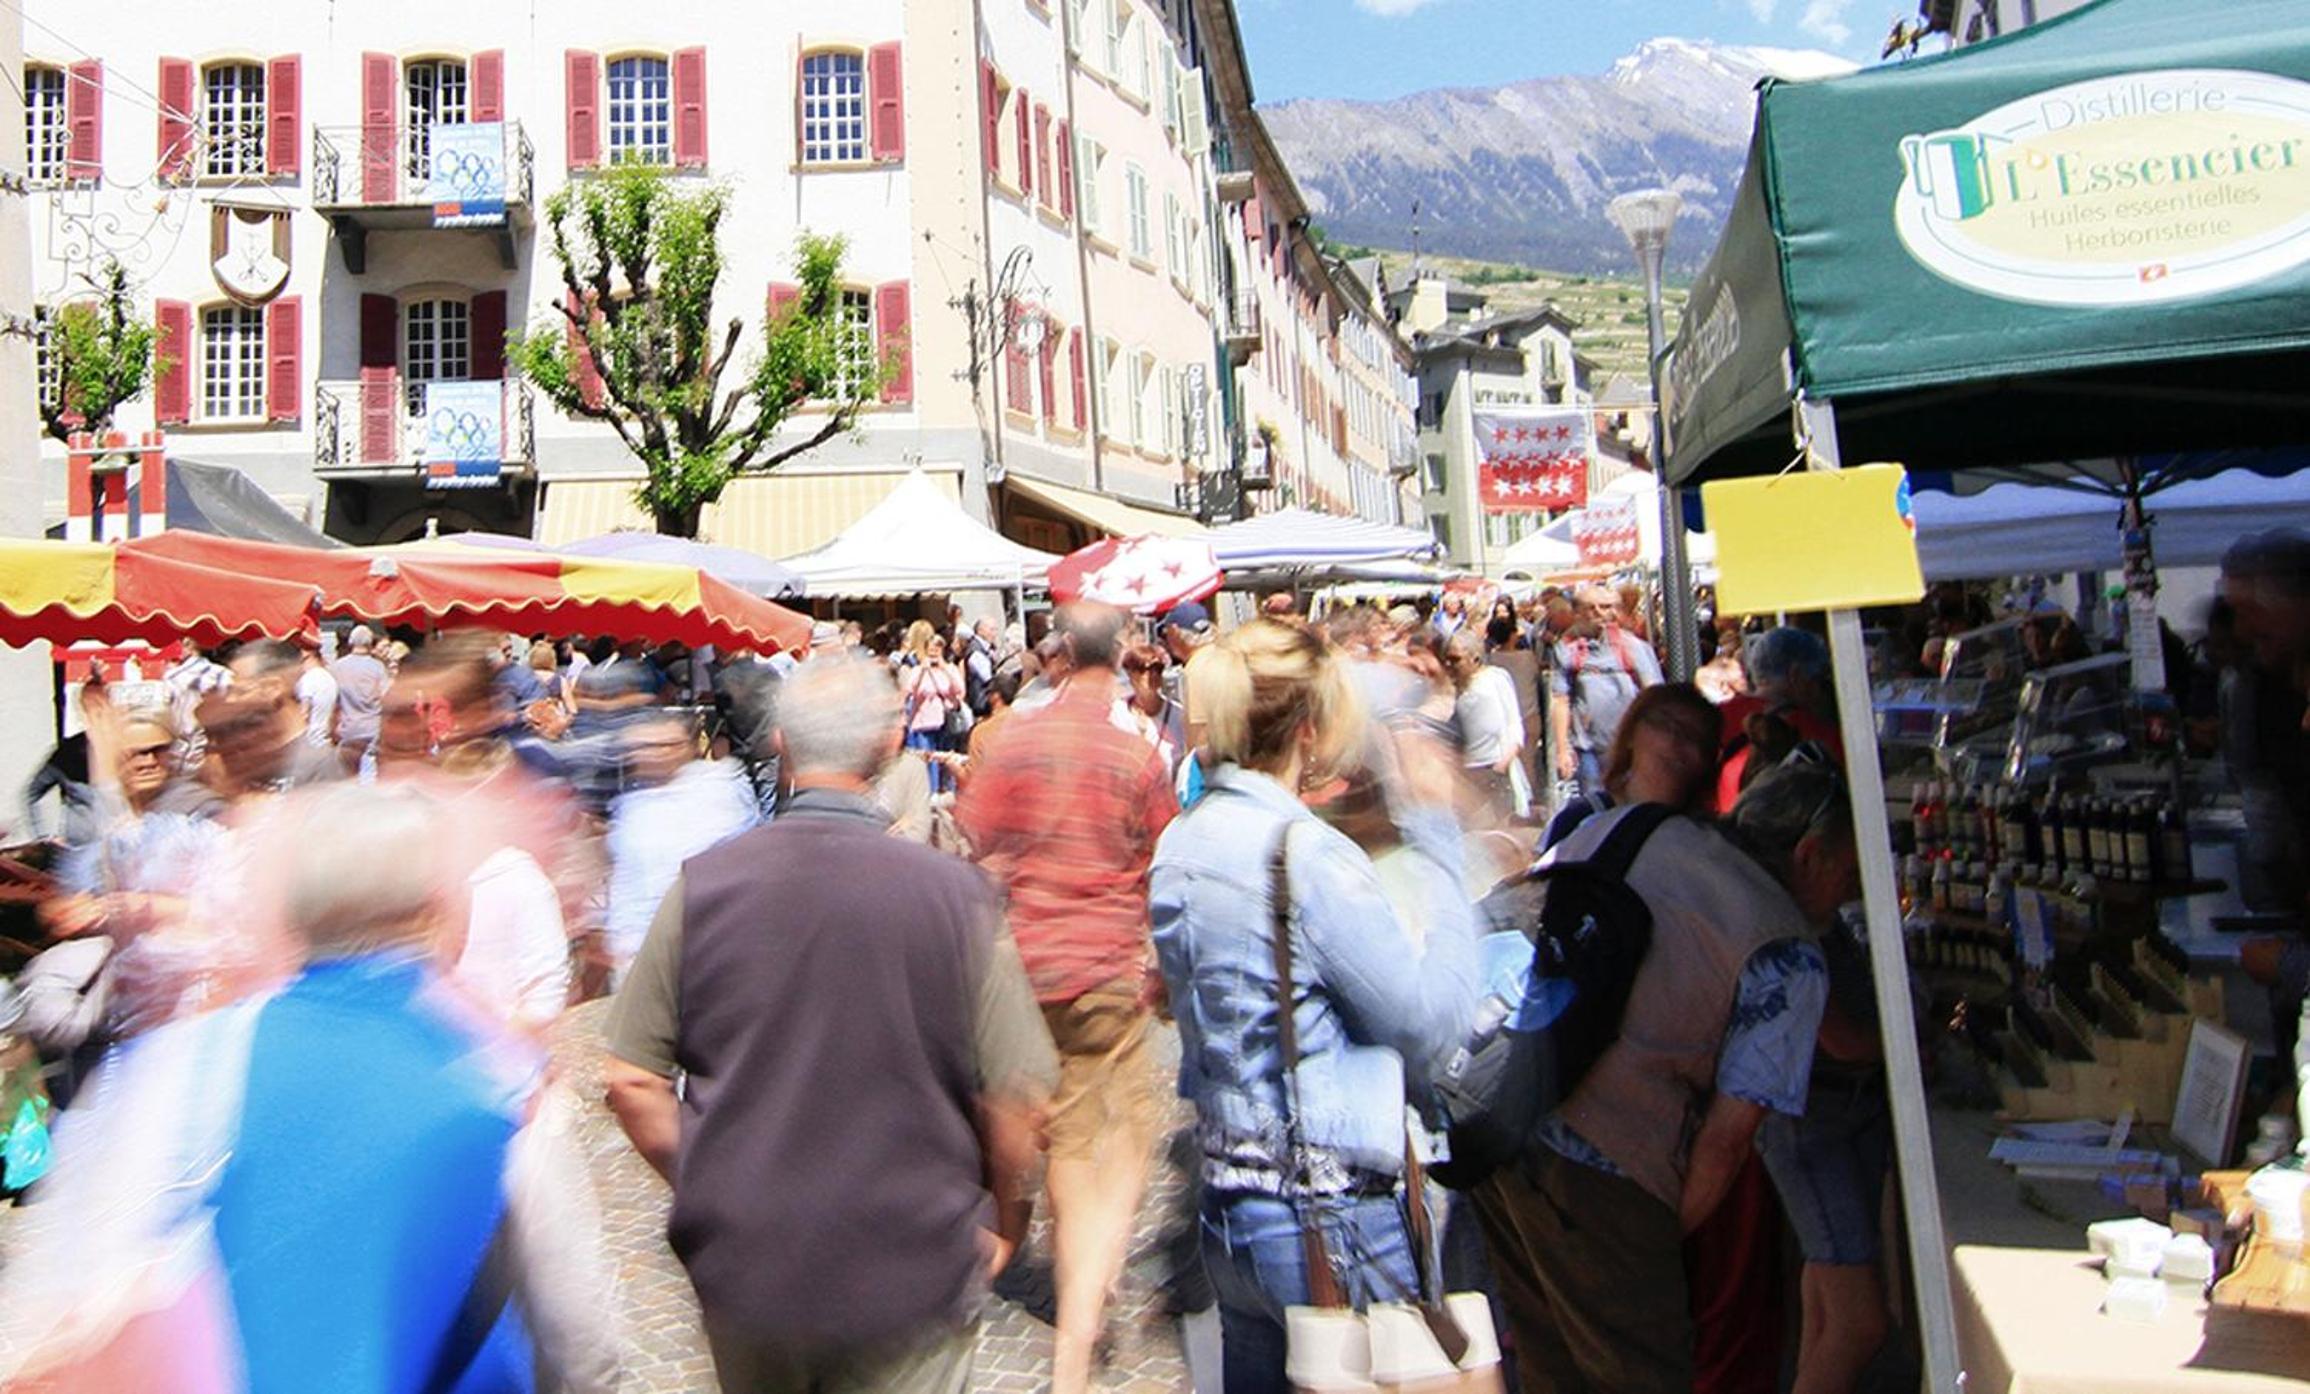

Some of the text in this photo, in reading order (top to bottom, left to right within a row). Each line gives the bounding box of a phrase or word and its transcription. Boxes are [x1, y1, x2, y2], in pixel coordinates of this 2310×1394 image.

[2040, 80, 2226, 132] Distillerie
[2006, 133, 2303, 203] L'Essencier
[2029, 183, 2261, 230] Huiles essentielles
[2065, 216, 2232, 253] Herboristerie
